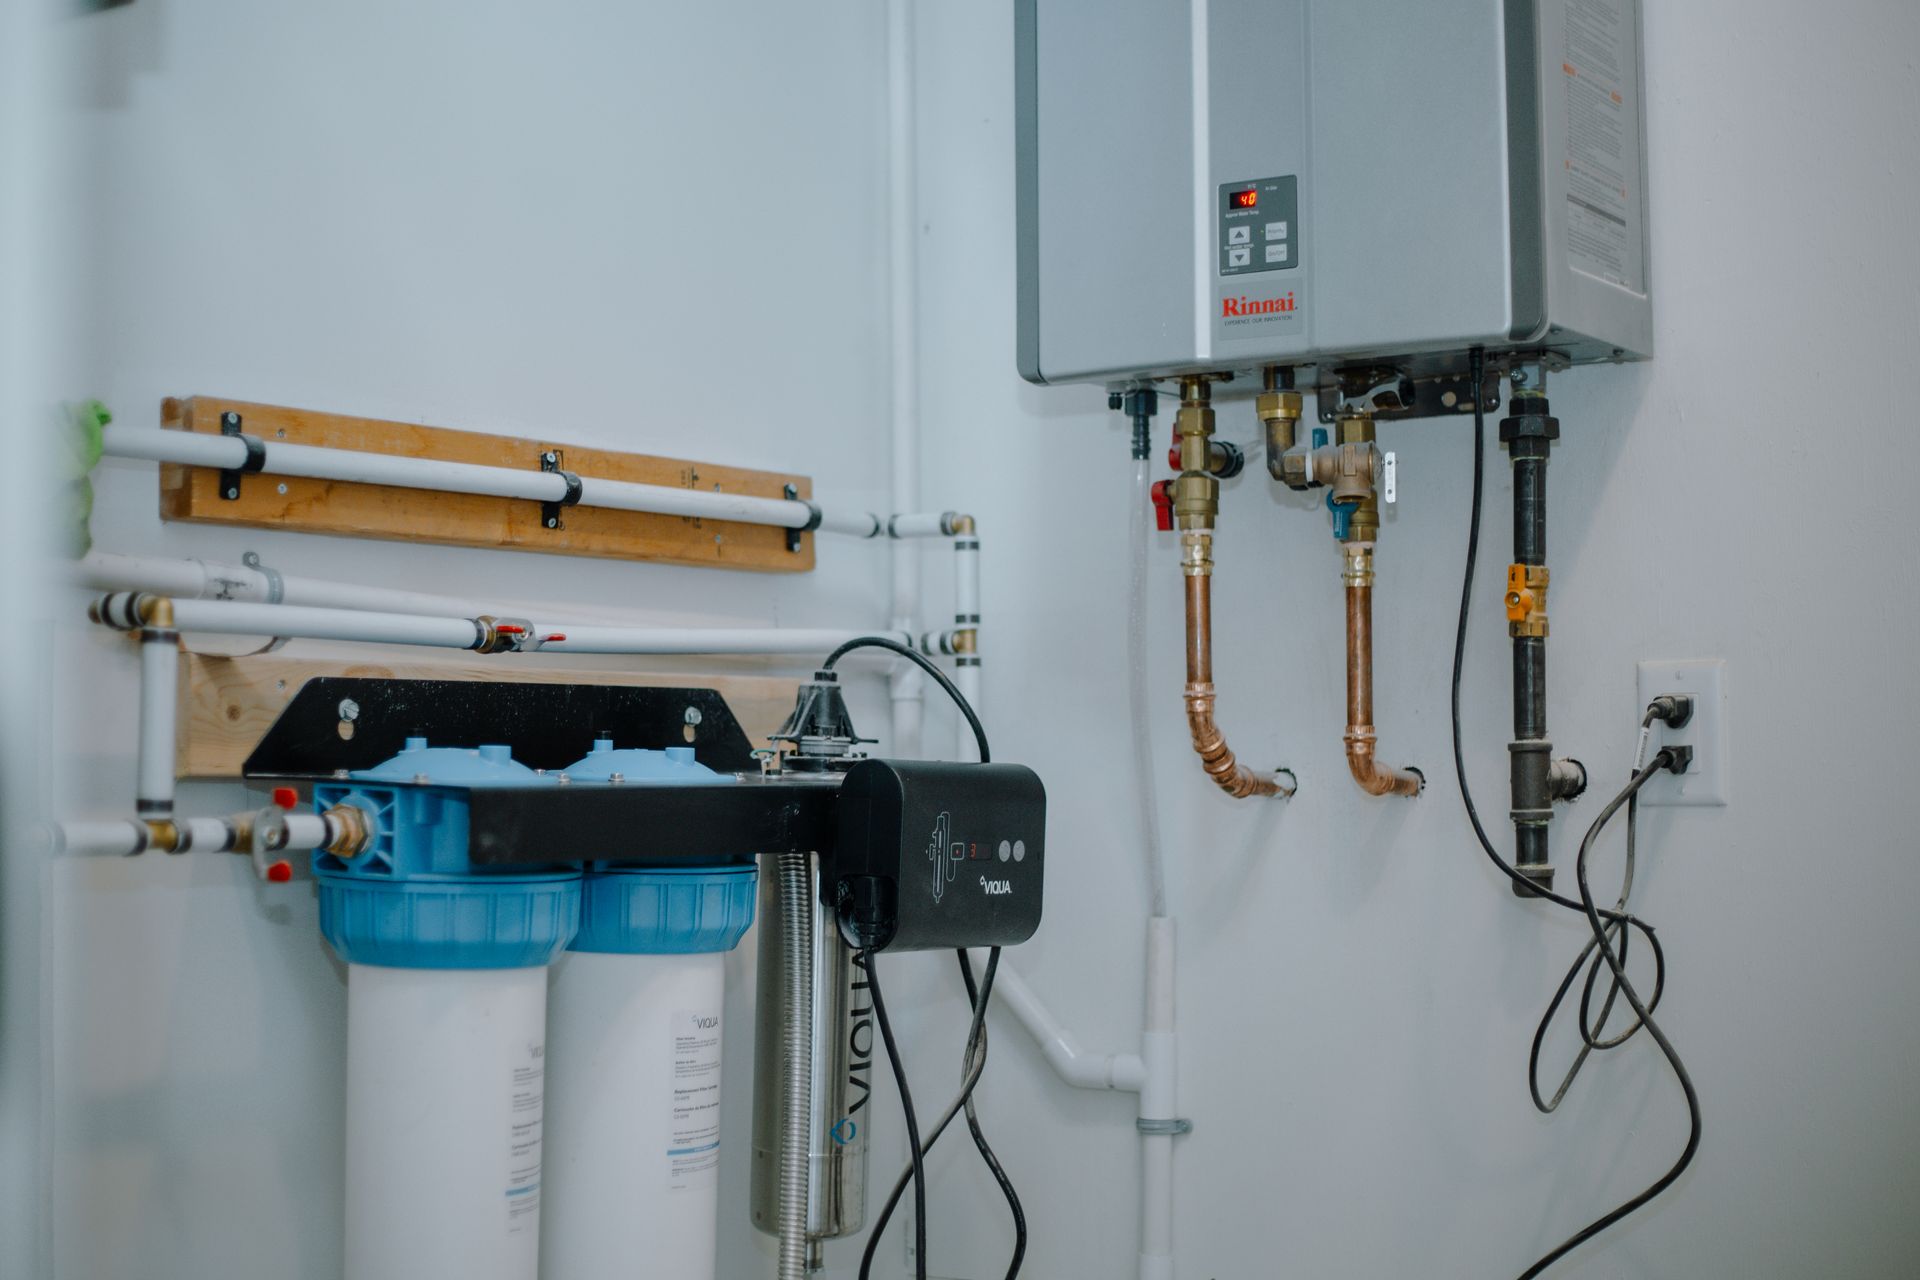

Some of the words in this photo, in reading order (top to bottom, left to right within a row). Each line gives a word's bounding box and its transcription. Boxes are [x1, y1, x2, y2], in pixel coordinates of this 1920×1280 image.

[1241, 192, 1256, 205] 40
[984, 880, 1011, 895] VIQUA
[697, 1016, 719, 1029] VIQUA
